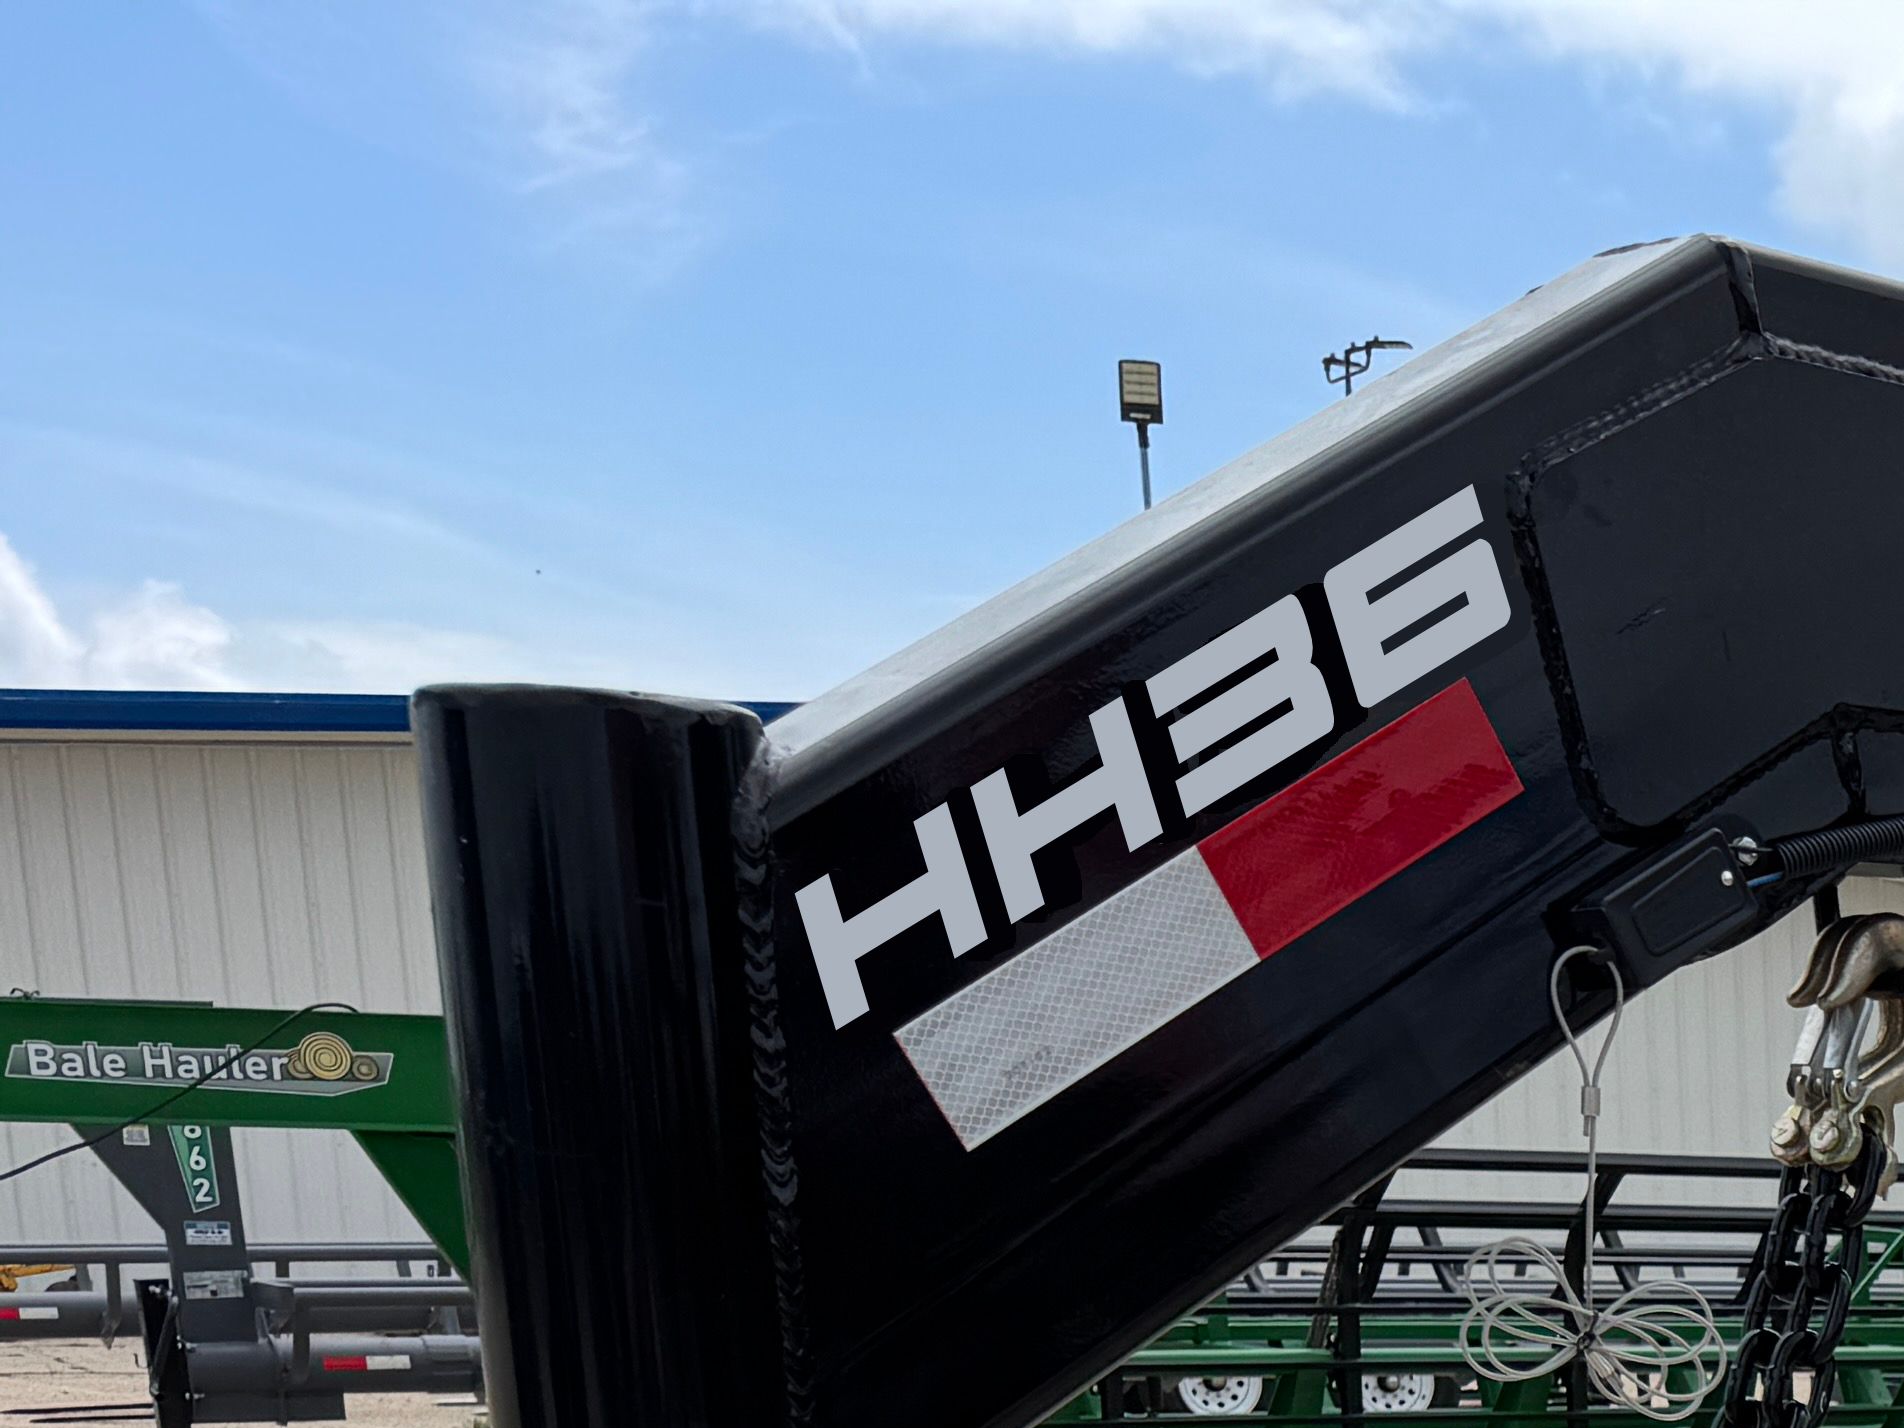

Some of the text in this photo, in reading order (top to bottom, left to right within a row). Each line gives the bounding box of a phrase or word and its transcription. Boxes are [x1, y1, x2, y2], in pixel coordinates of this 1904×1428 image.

[795, 483, 1511, 1031] HH36
[27, 1043, 289, 1080] Bale Hauler
